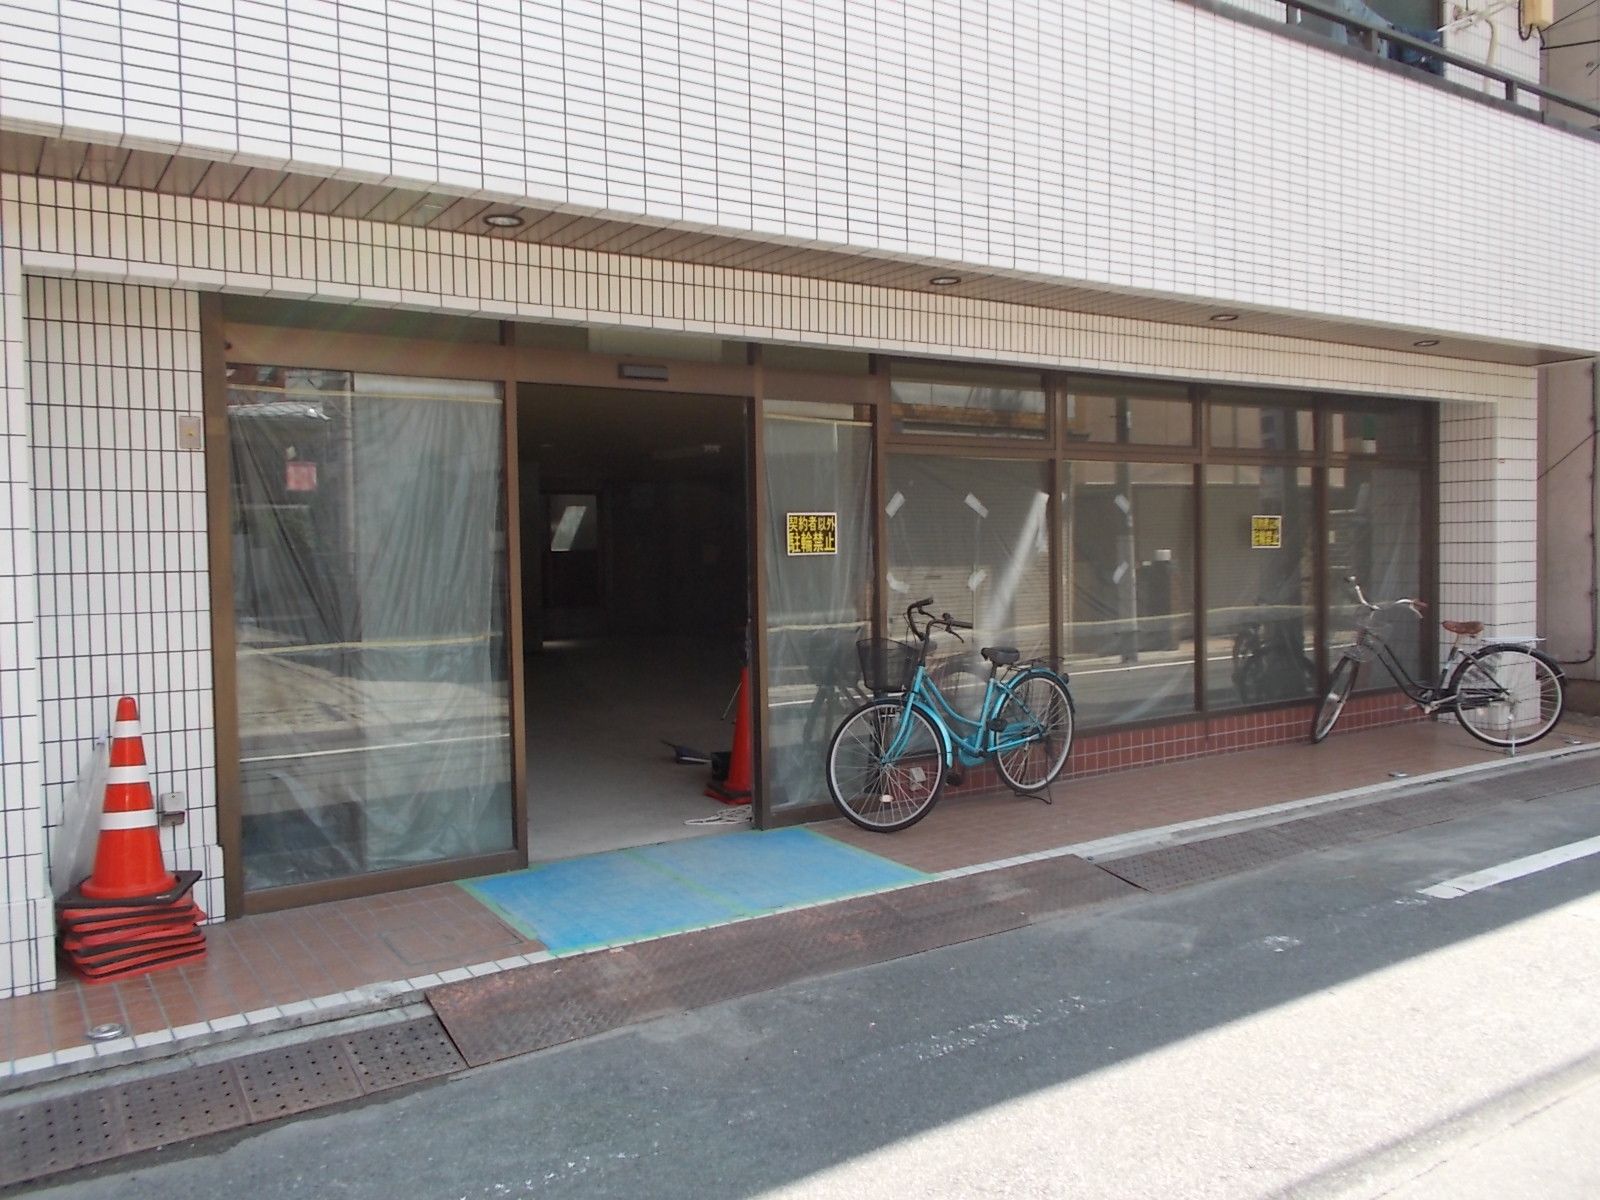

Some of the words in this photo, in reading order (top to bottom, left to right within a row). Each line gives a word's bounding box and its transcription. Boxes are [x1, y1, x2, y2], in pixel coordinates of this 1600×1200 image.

[789, 516, 835, 531] 契約者以外
[789, 532, 835, 552] 駐輪禁止
